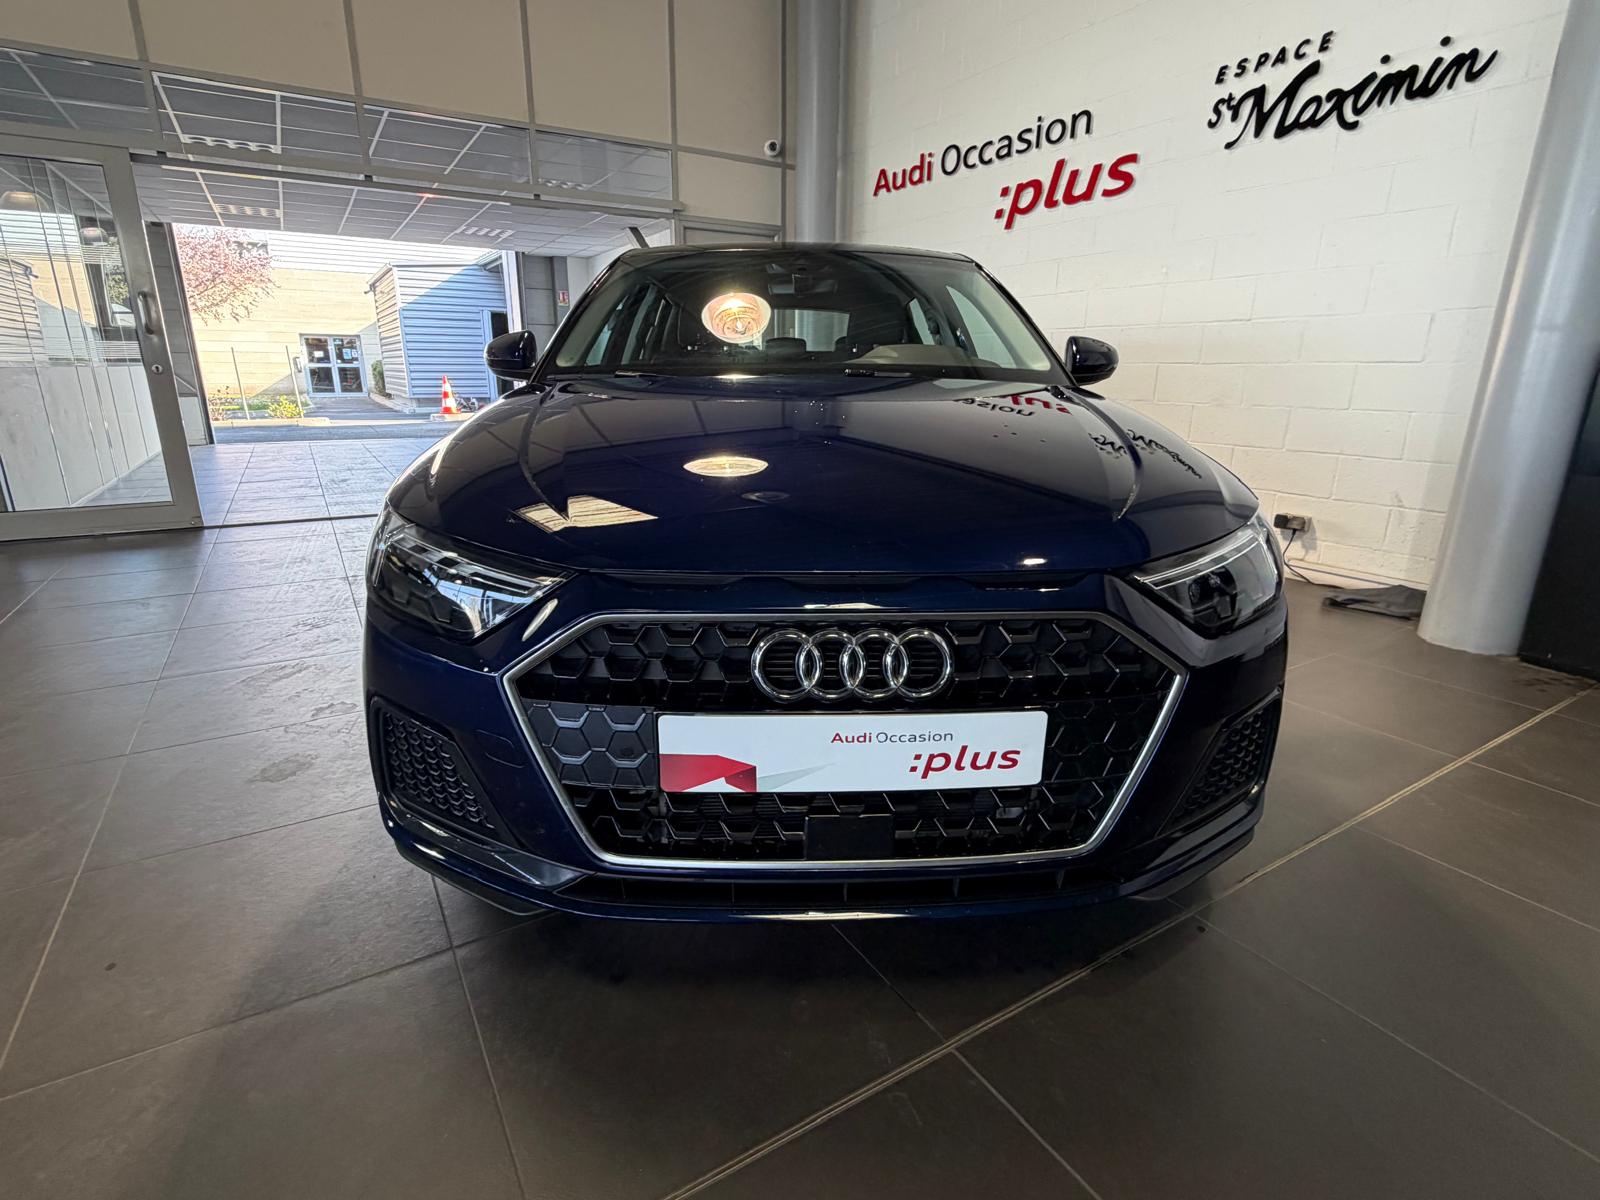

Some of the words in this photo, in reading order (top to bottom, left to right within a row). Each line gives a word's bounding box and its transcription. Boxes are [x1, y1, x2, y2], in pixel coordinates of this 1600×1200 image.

[1214, 30, 1335, 85] ESPACE
[1224, 36, 1499, 150] Maximin
[873, 152, 934, 196] Audi
[940, 109, 1093, 176] Occasion
[994, 153, 1139, 230] :plus
[830, 731, 873, 744] Audi
[875, 730, 954, 744] Occasion
[908, 745, 1021, 780] :plus
